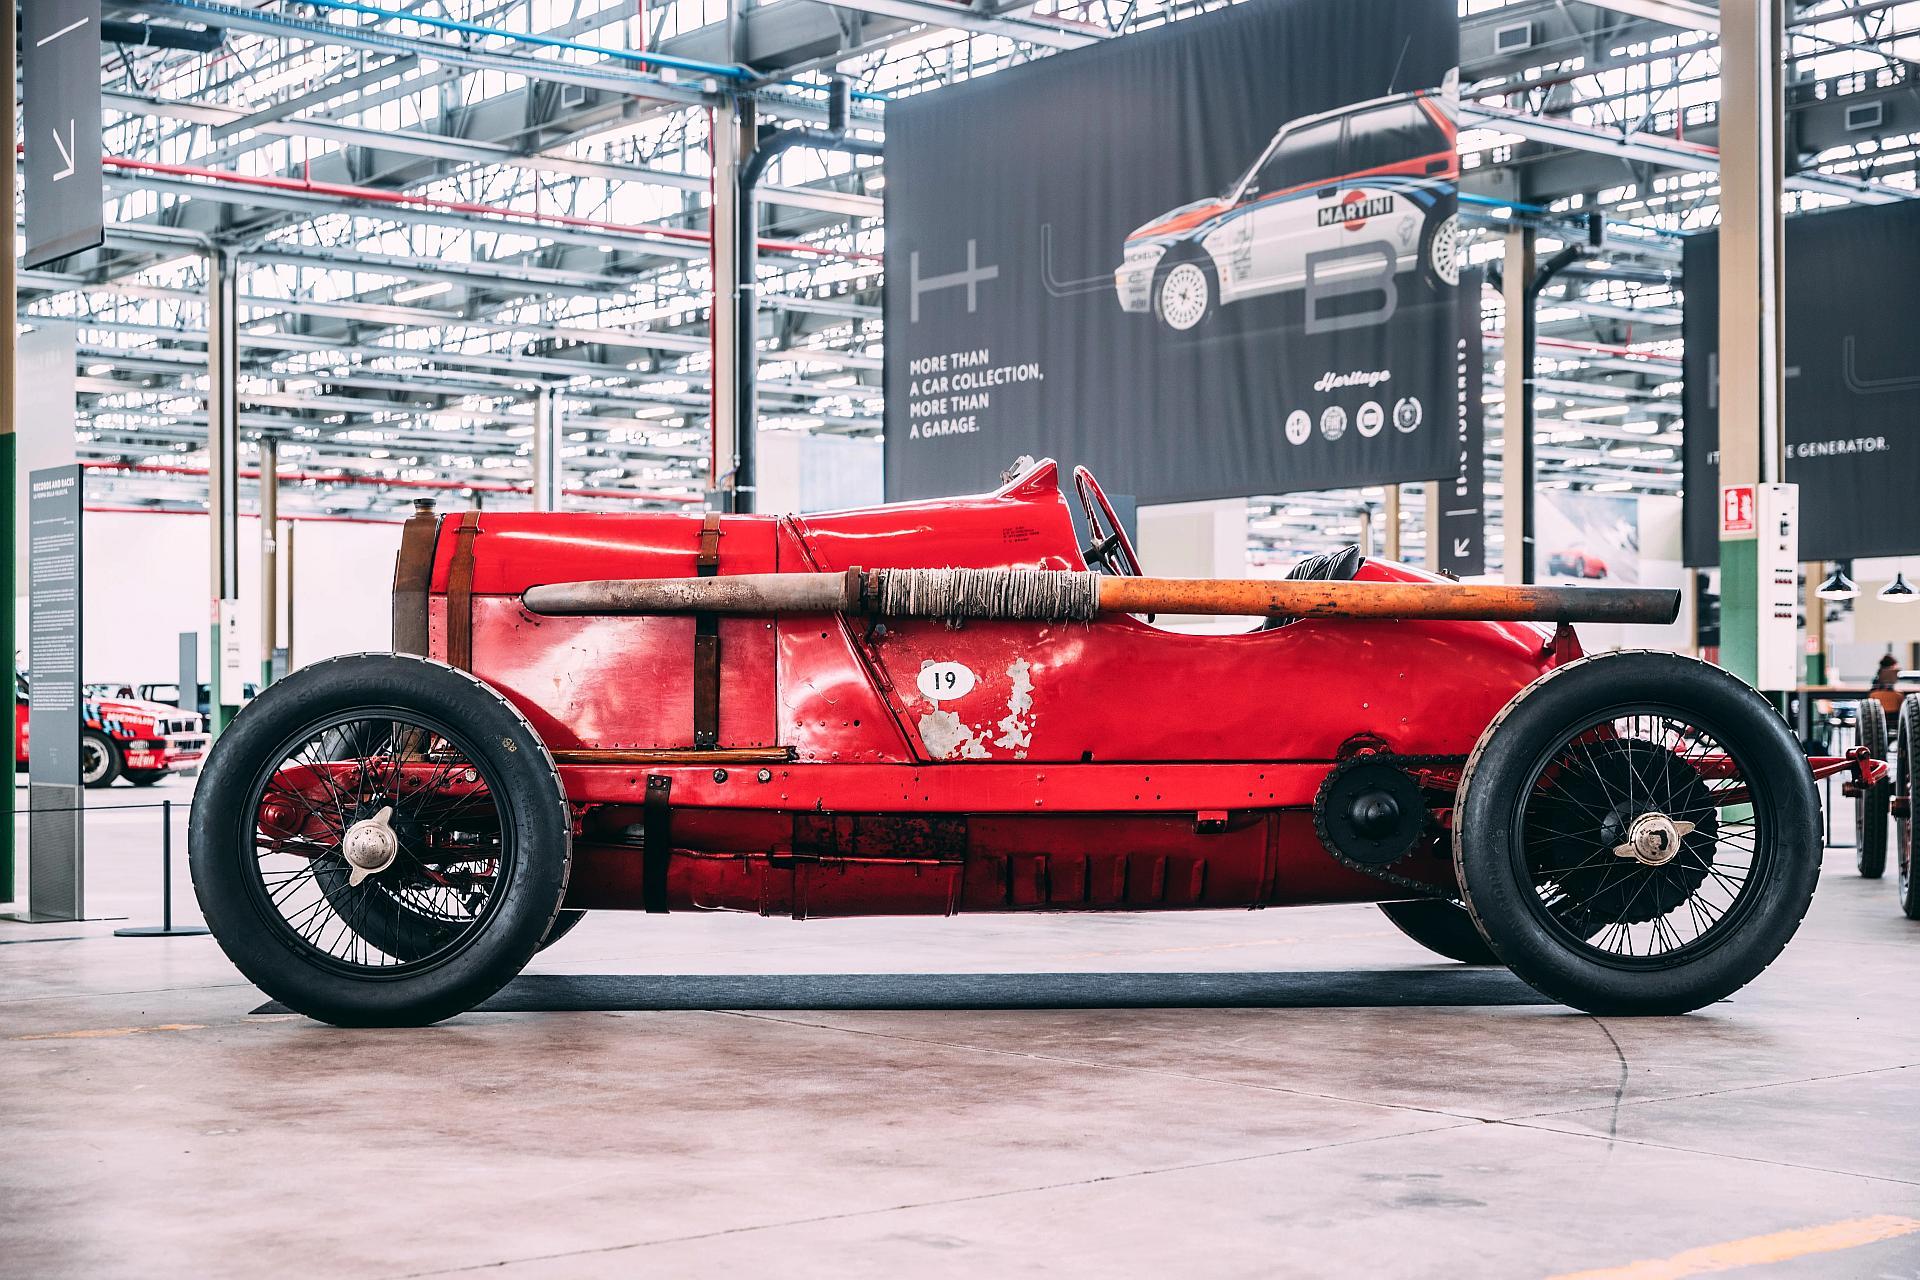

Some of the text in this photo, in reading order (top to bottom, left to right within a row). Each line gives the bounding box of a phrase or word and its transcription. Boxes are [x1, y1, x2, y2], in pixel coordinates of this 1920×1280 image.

[1320, 197, 1392, 226] MARTINI
[910, 348, 989, 376] MORE THAN
[909, 381, 919, 397] A
[922, 376, 949, 395] CAR
[1313, 370, 1391, 392] Heritage
[910, 392, 989, 418] MORE THAN
[909, 416, 980, 440] A GARAGE.
[935, 671, 956, 690] 19
